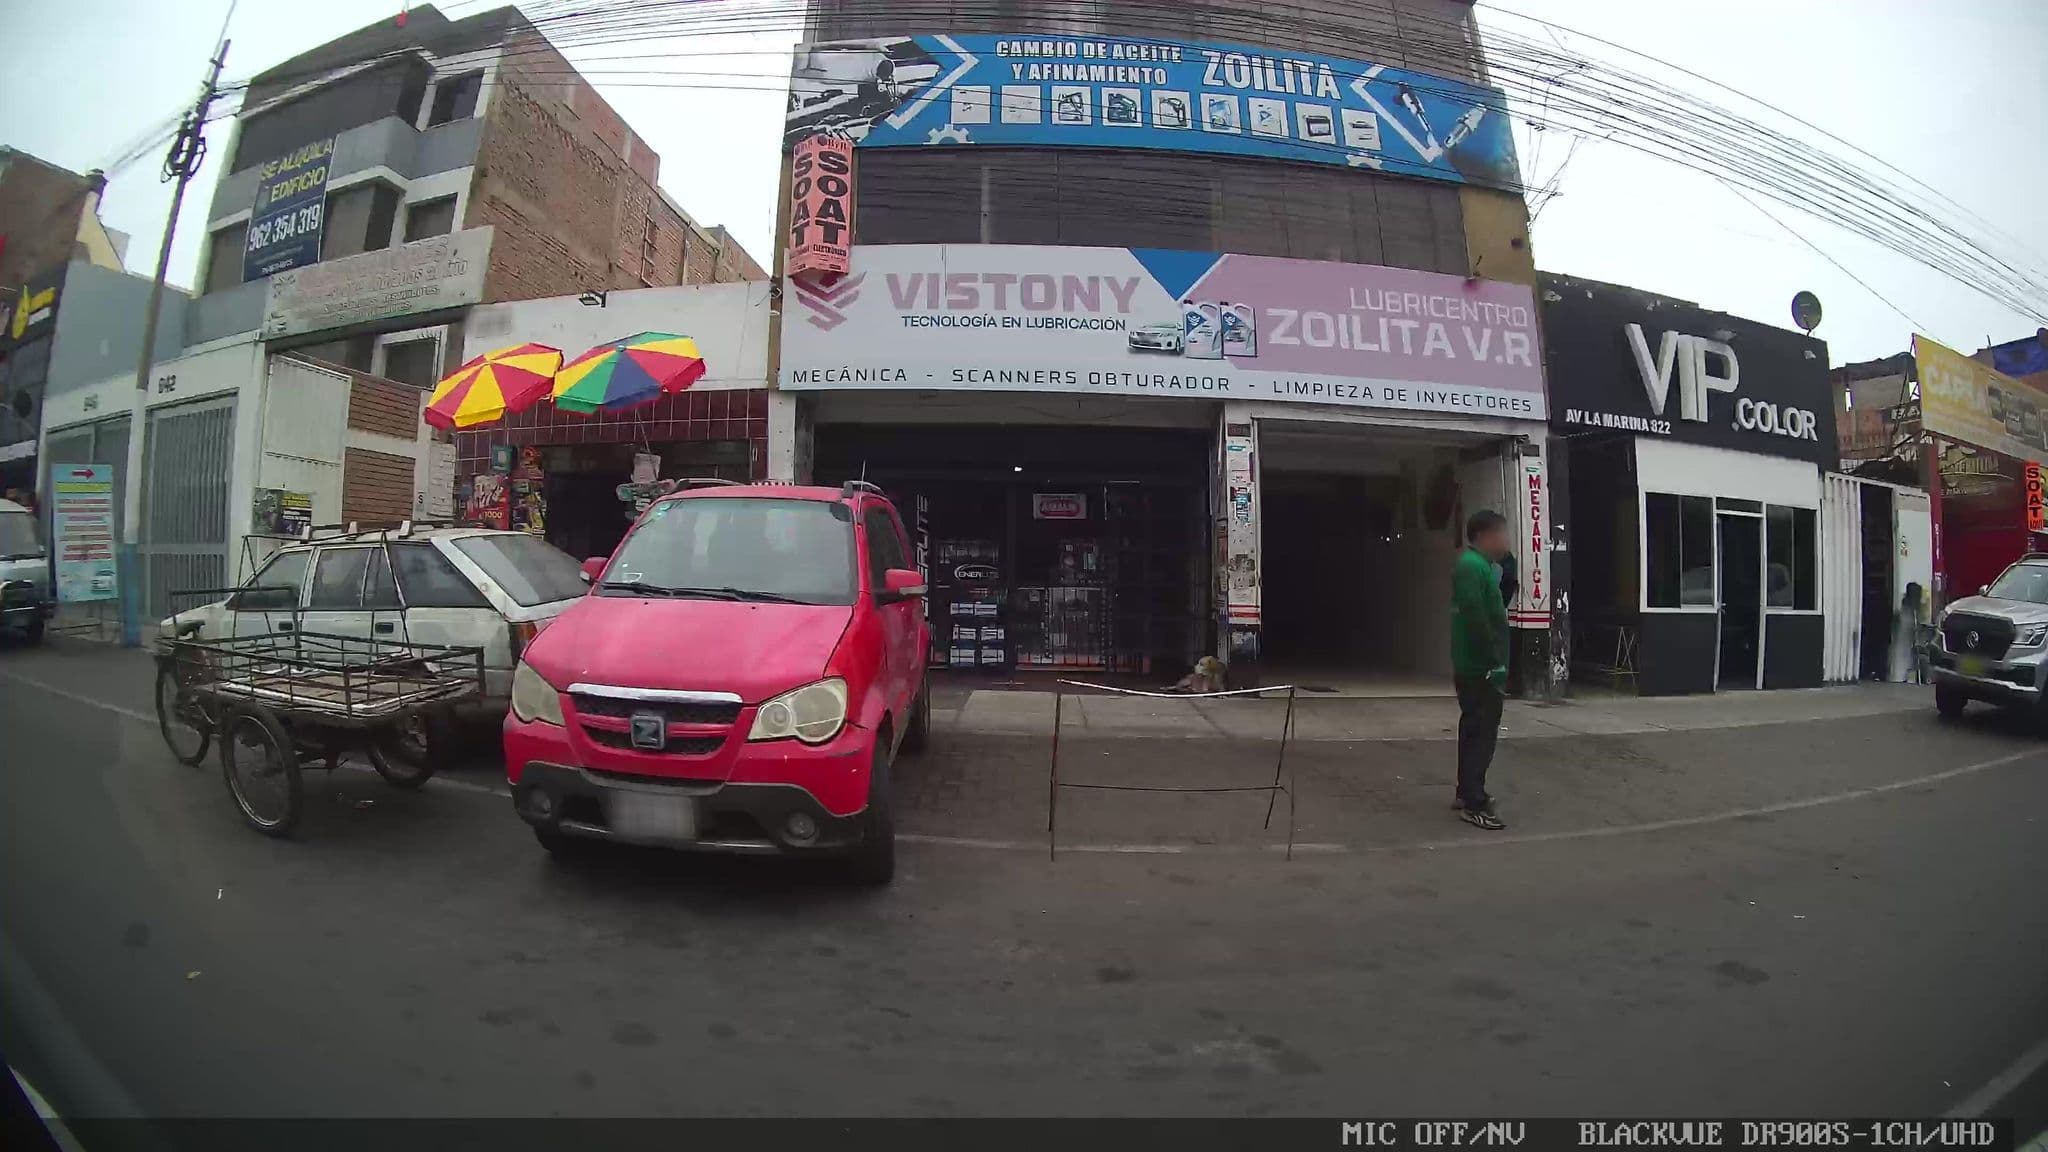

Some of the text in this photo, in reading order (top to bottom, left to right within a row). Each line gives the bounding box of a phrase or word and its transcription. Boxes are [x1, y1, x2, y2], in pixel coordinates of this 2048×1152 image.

[996, 40, 1183, 63] CAMBIO DE ACEITE
[1011, 63, 1168, 85] Y AFINAMIENTO
[1201, 49, 1342, 101] ZOILITA
[261, 138, 333, 181] SE ALQUILA
[271, 166, 326, 202] EDIFICIO
[792, 151, 813, 247] SOAT
[815, 151, 849, 245] SOAT
[248, 203, 321, 251] 962 354 319
[886, 272, 1141, 314] VISTONY
[1350, 287, 1528, 327] LUBRICENTRO
[902, 313, 1126, 332] TECNOLOGÍA EN LUBRICACIÓN
[1267, 307, 1533, 367] ZOILITA V.R
[793, 366, 907, 384] MECÁNICA
[952, 368, 1077, 385] SCANNERS
[1088, 371, 1230, 391] OBTURADOR
[1273, 380, 1374, 400] LIMPIEZA
[1383, 387, 1408, 402] DE
[1417, 390, 1532, 413] INYECTORES
[1624, 322, 1740, 423] VIP
[1566, 408, 1671, 435] AV LA MARINA 822
[2027, 467, 2042, 518] SOAT
[1528, 474, 1541, 600] MECANICA
